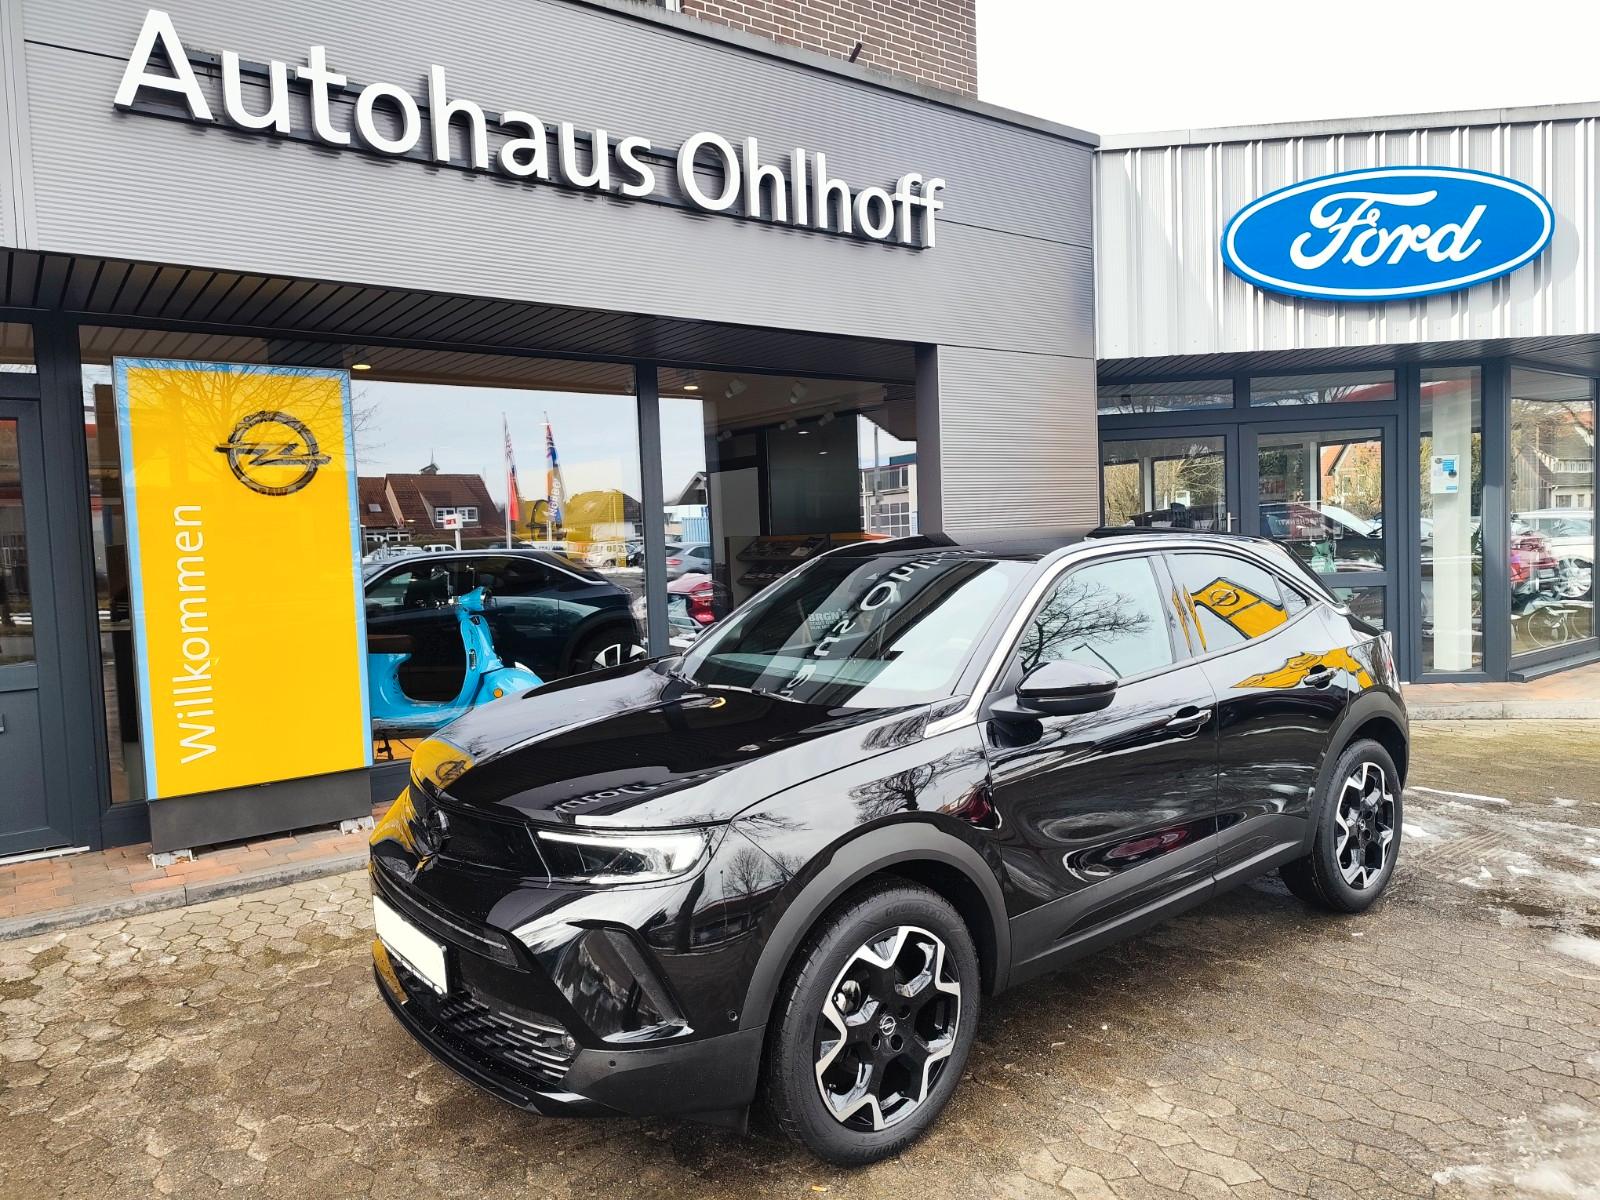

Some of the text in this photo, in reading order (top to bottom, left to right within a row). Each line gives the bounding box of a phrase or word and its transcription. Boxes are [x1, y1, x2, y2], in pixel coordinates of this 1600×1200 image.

[114, 9, 946, 248] Autohaus Ohlhoff
[1290, 189, 1488, 270] Ford
[172, 504, 217, 764] Willkommen
